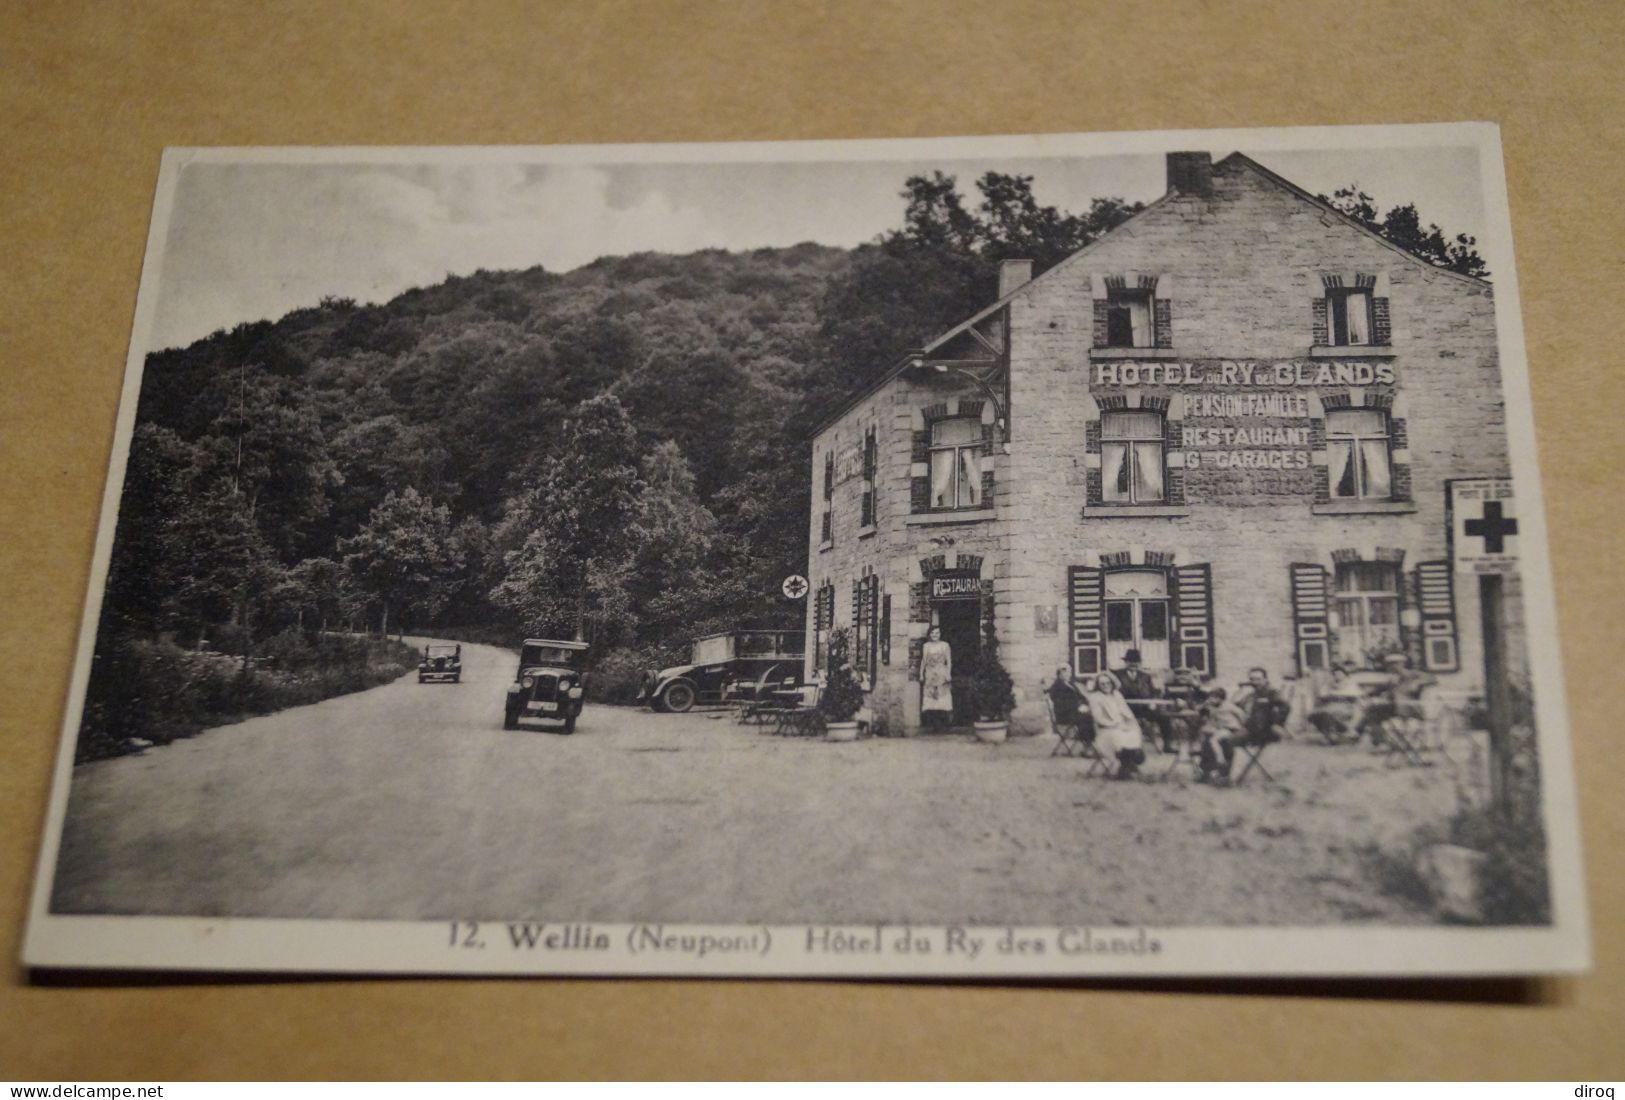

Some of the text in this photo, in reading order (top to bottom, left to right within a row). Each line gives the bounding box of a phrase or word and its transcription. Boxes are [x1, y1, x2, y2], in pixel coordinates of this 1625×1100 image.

[1221, 362, 1256, 384] RY
[1274, 362, 1395, 385] GLANDS
[1182, 427, 1311, 446] RESTAURANT
[933, 577, 985, 597] RESTAURAN
[448, 921, 1163, 959] 12. Wellin (Neupont) Hôtel du Ry des Glands
